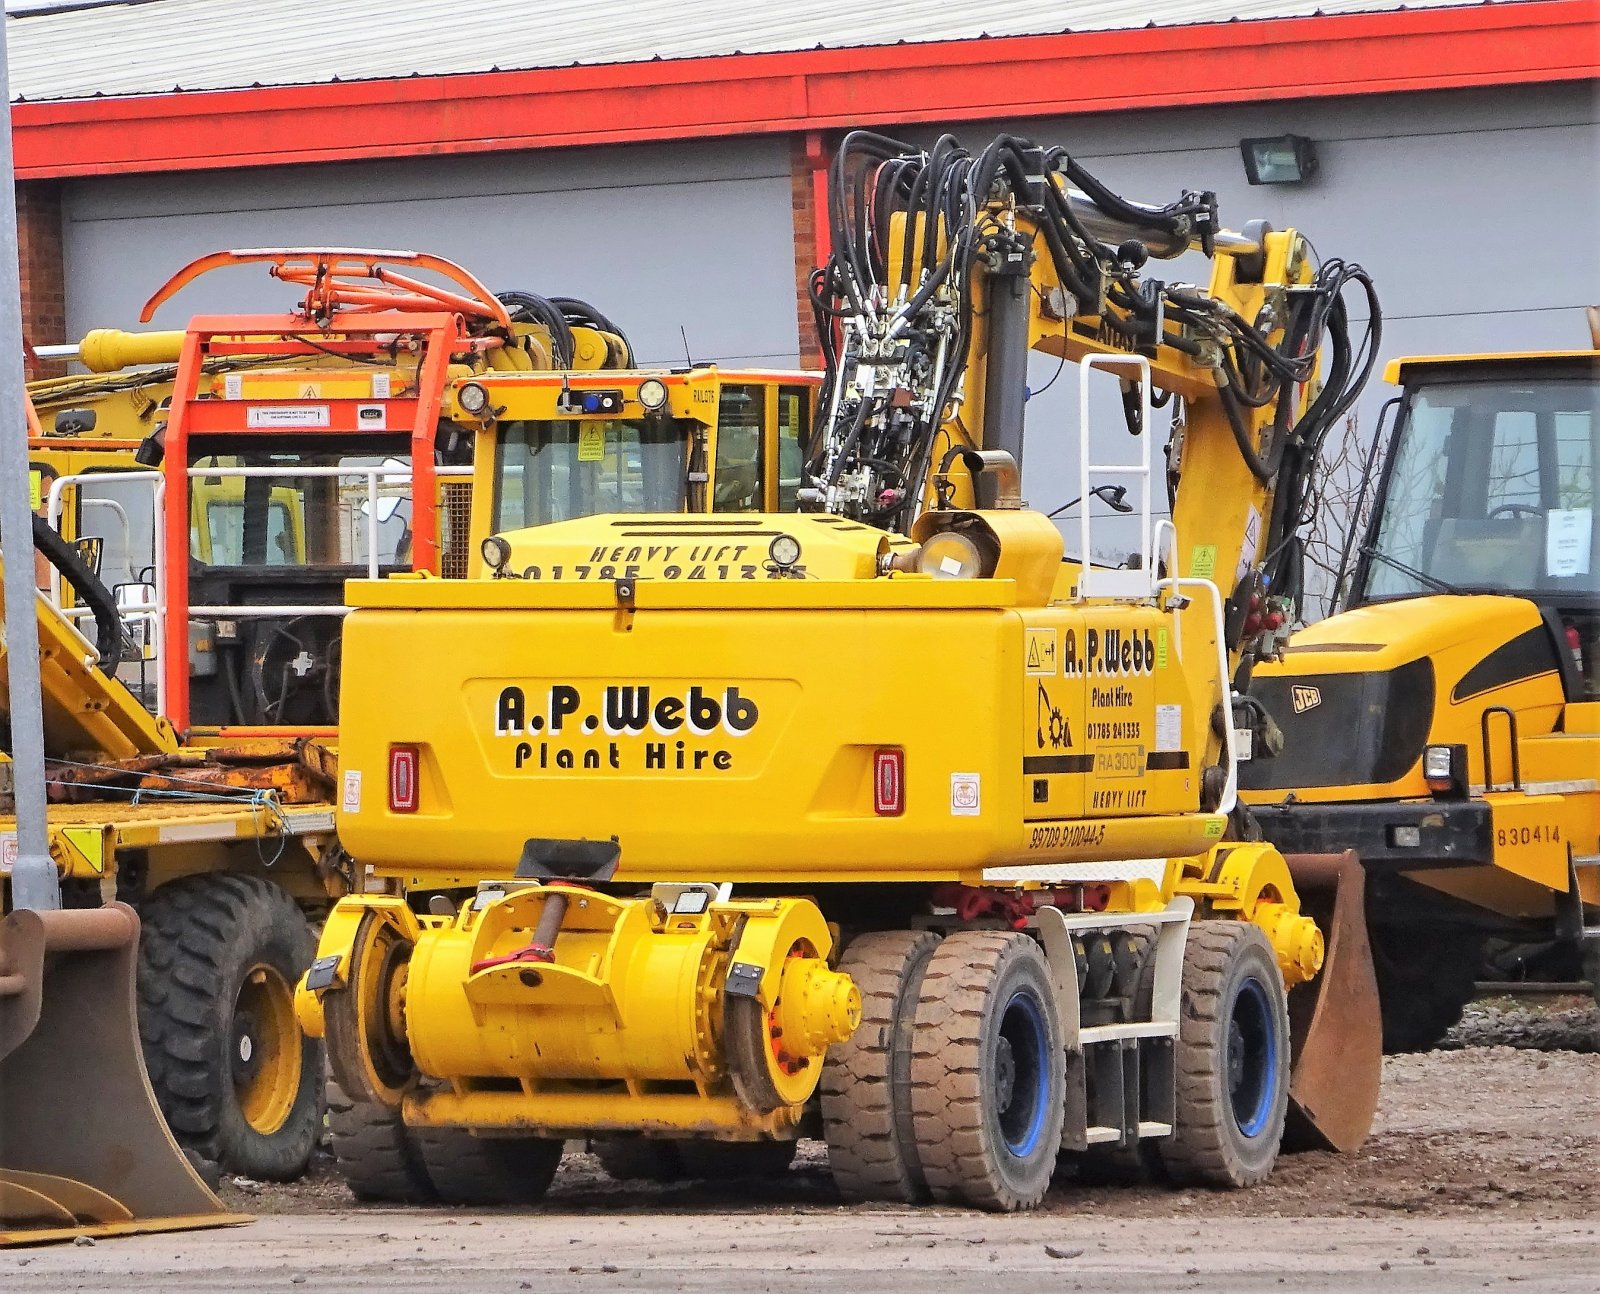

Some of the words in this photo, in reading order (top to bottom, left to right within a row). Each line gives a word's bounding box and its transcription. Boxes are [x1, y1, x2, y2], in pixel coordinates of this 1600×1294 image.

[589, 545, 680, 563] HEAVY
[689, 545, 749, 562] LIFT
[1091, 687, 1113, 708] Plant
[1115, 685, 1133, 707] Hire
[1294, 688, 1319, 711] JCB
[495, 685, 759, 736] A.P.Webb
[1087, 722, 1110, 740] 01785
[1112, 721, 1140, 739] 241335
[515, 742, 620, 769] Plant
[645, 740, 733, 770] Hire
[1097, 752, 1137, 771] RA300
[1092, 790, 1123, 809] HEAVY
[1127, 789, 1147, 808] LIFT
[1029, 826, 1060, 849] 99709
[1498, 825, 1560, 847] 830414
